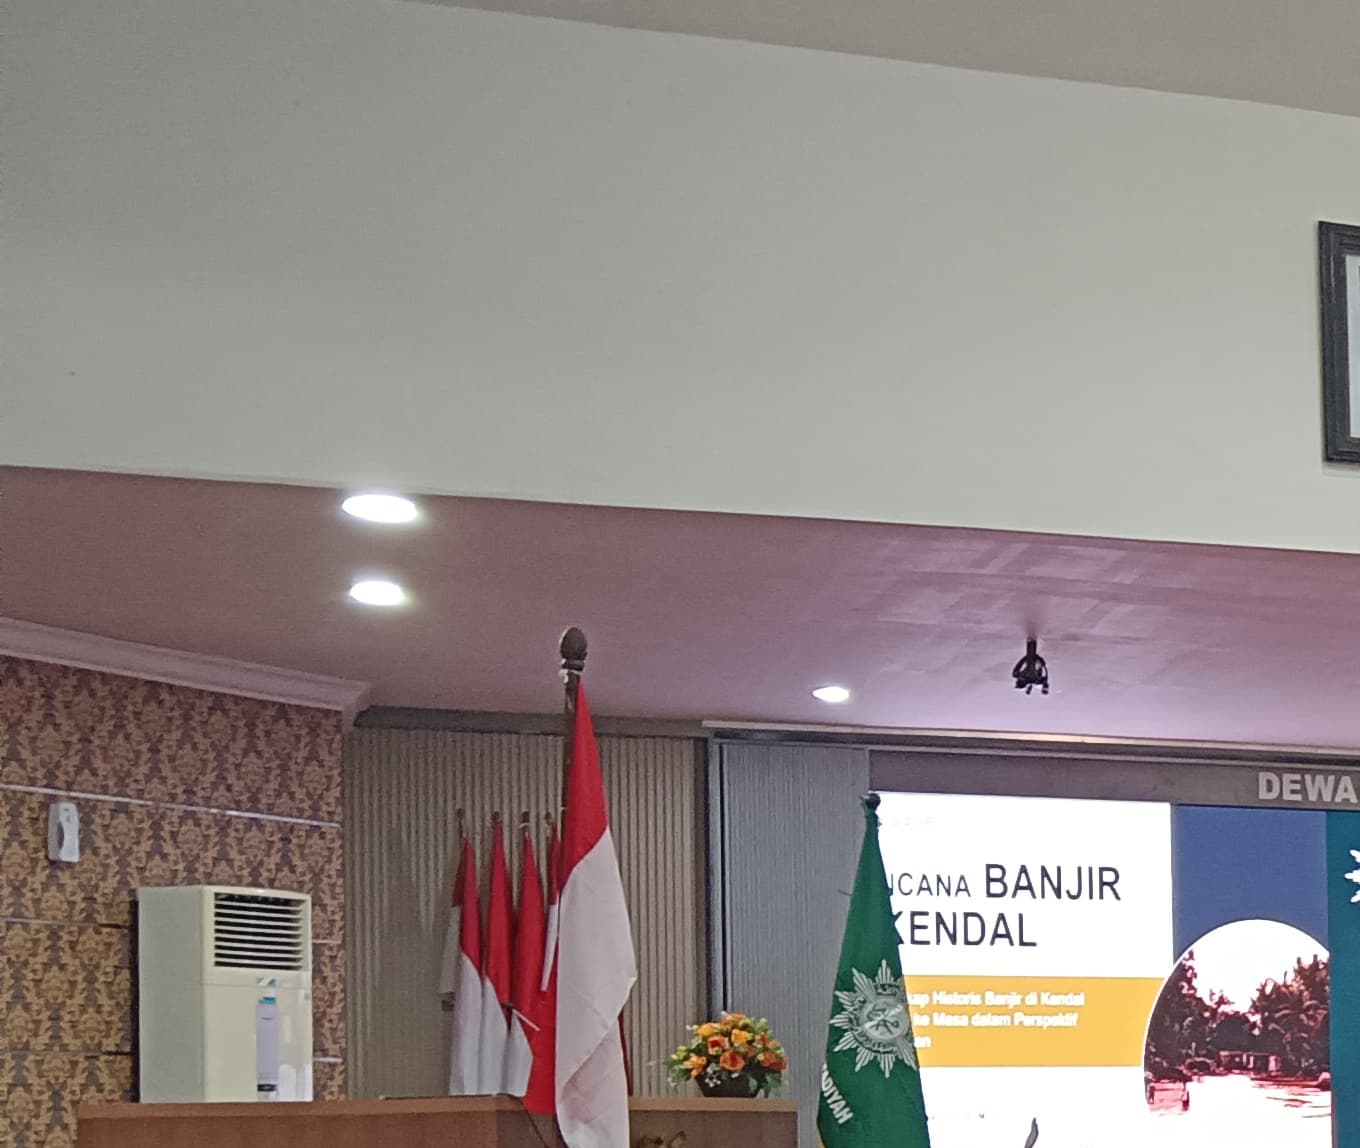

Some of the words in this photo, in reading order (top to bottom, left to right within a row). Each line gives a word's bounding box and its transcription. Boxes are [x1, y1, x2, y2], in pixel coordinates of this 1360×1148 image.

[985, 863, 1121, 901] BANJIR
[984, 990, 1024, 1010] Banjir
[1025, 991, 1038, 1007] di
[1040, 991, 1086, 1007] Kendal
[932, 1012, 969, 1028] Masa
[971, 1012, 1012, 1028] dalam
